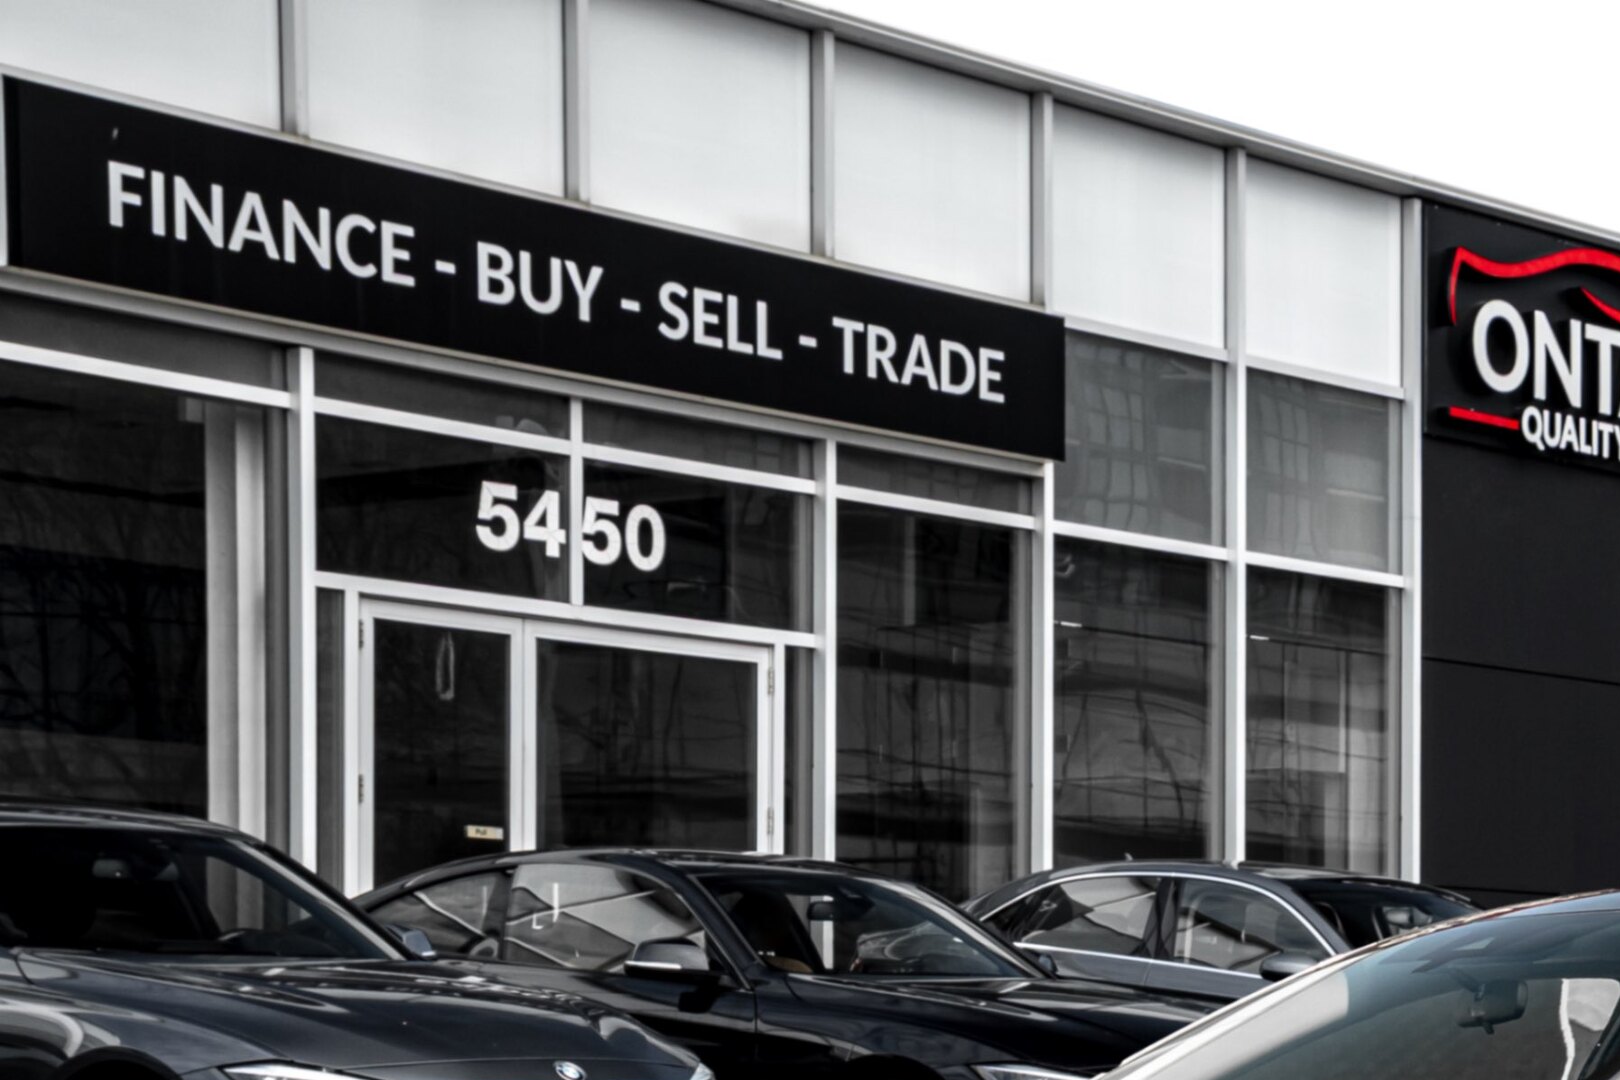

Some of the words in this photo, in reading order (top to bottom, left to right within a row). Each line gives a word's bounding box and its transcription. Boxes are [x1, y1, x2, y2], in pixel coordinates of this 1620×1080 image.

[107, 160, 416, 287] FINANCE
[477, 242, 604, 322] BUY
[658, 281, 783, 360] SELL
[832, 316, 1006, 404] TRADE
[475, 481, 666, 572] 5450
